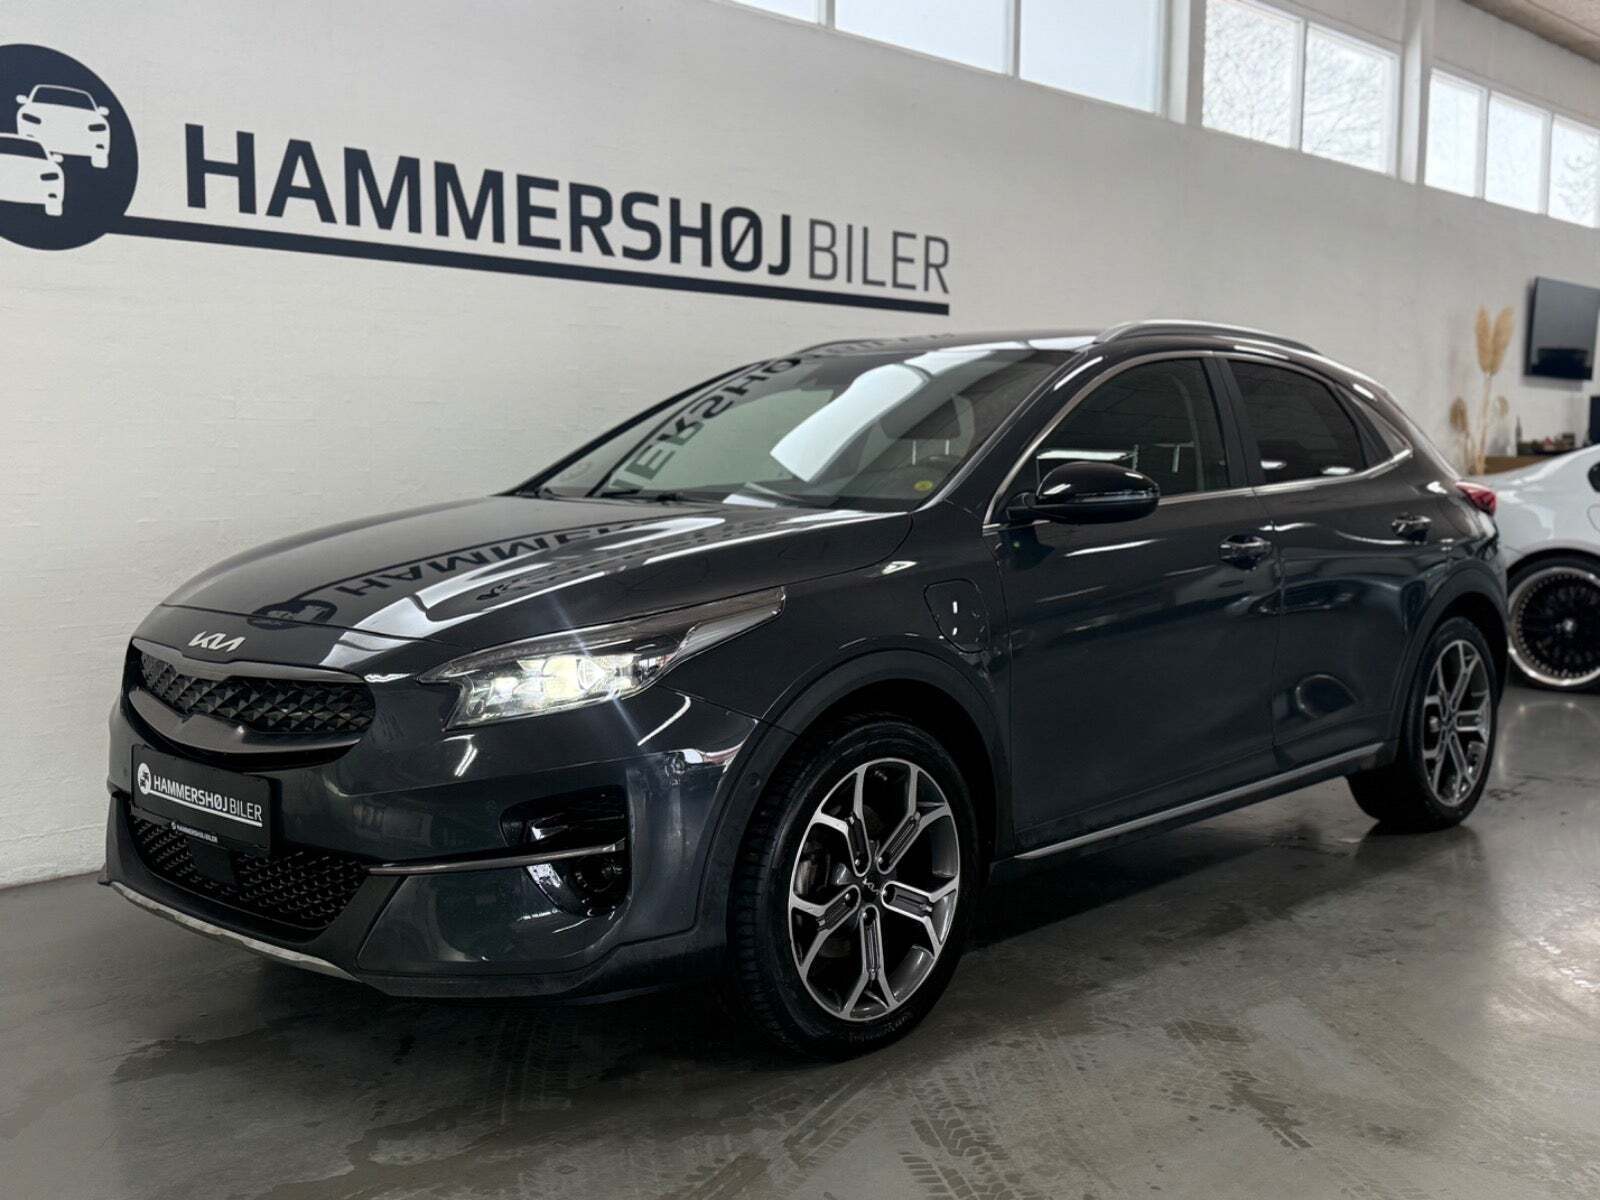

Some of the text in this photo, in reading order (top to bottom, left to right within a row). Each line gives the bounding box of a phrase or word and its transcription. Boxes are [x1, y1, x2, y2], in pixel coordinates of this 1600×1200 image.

[185, 122, 950, 295] HAMMERSHØJ BILER
[188, 630, 246, 653] KIA
[153, 775, 262, 821] HAMMERSHØJ BILER
